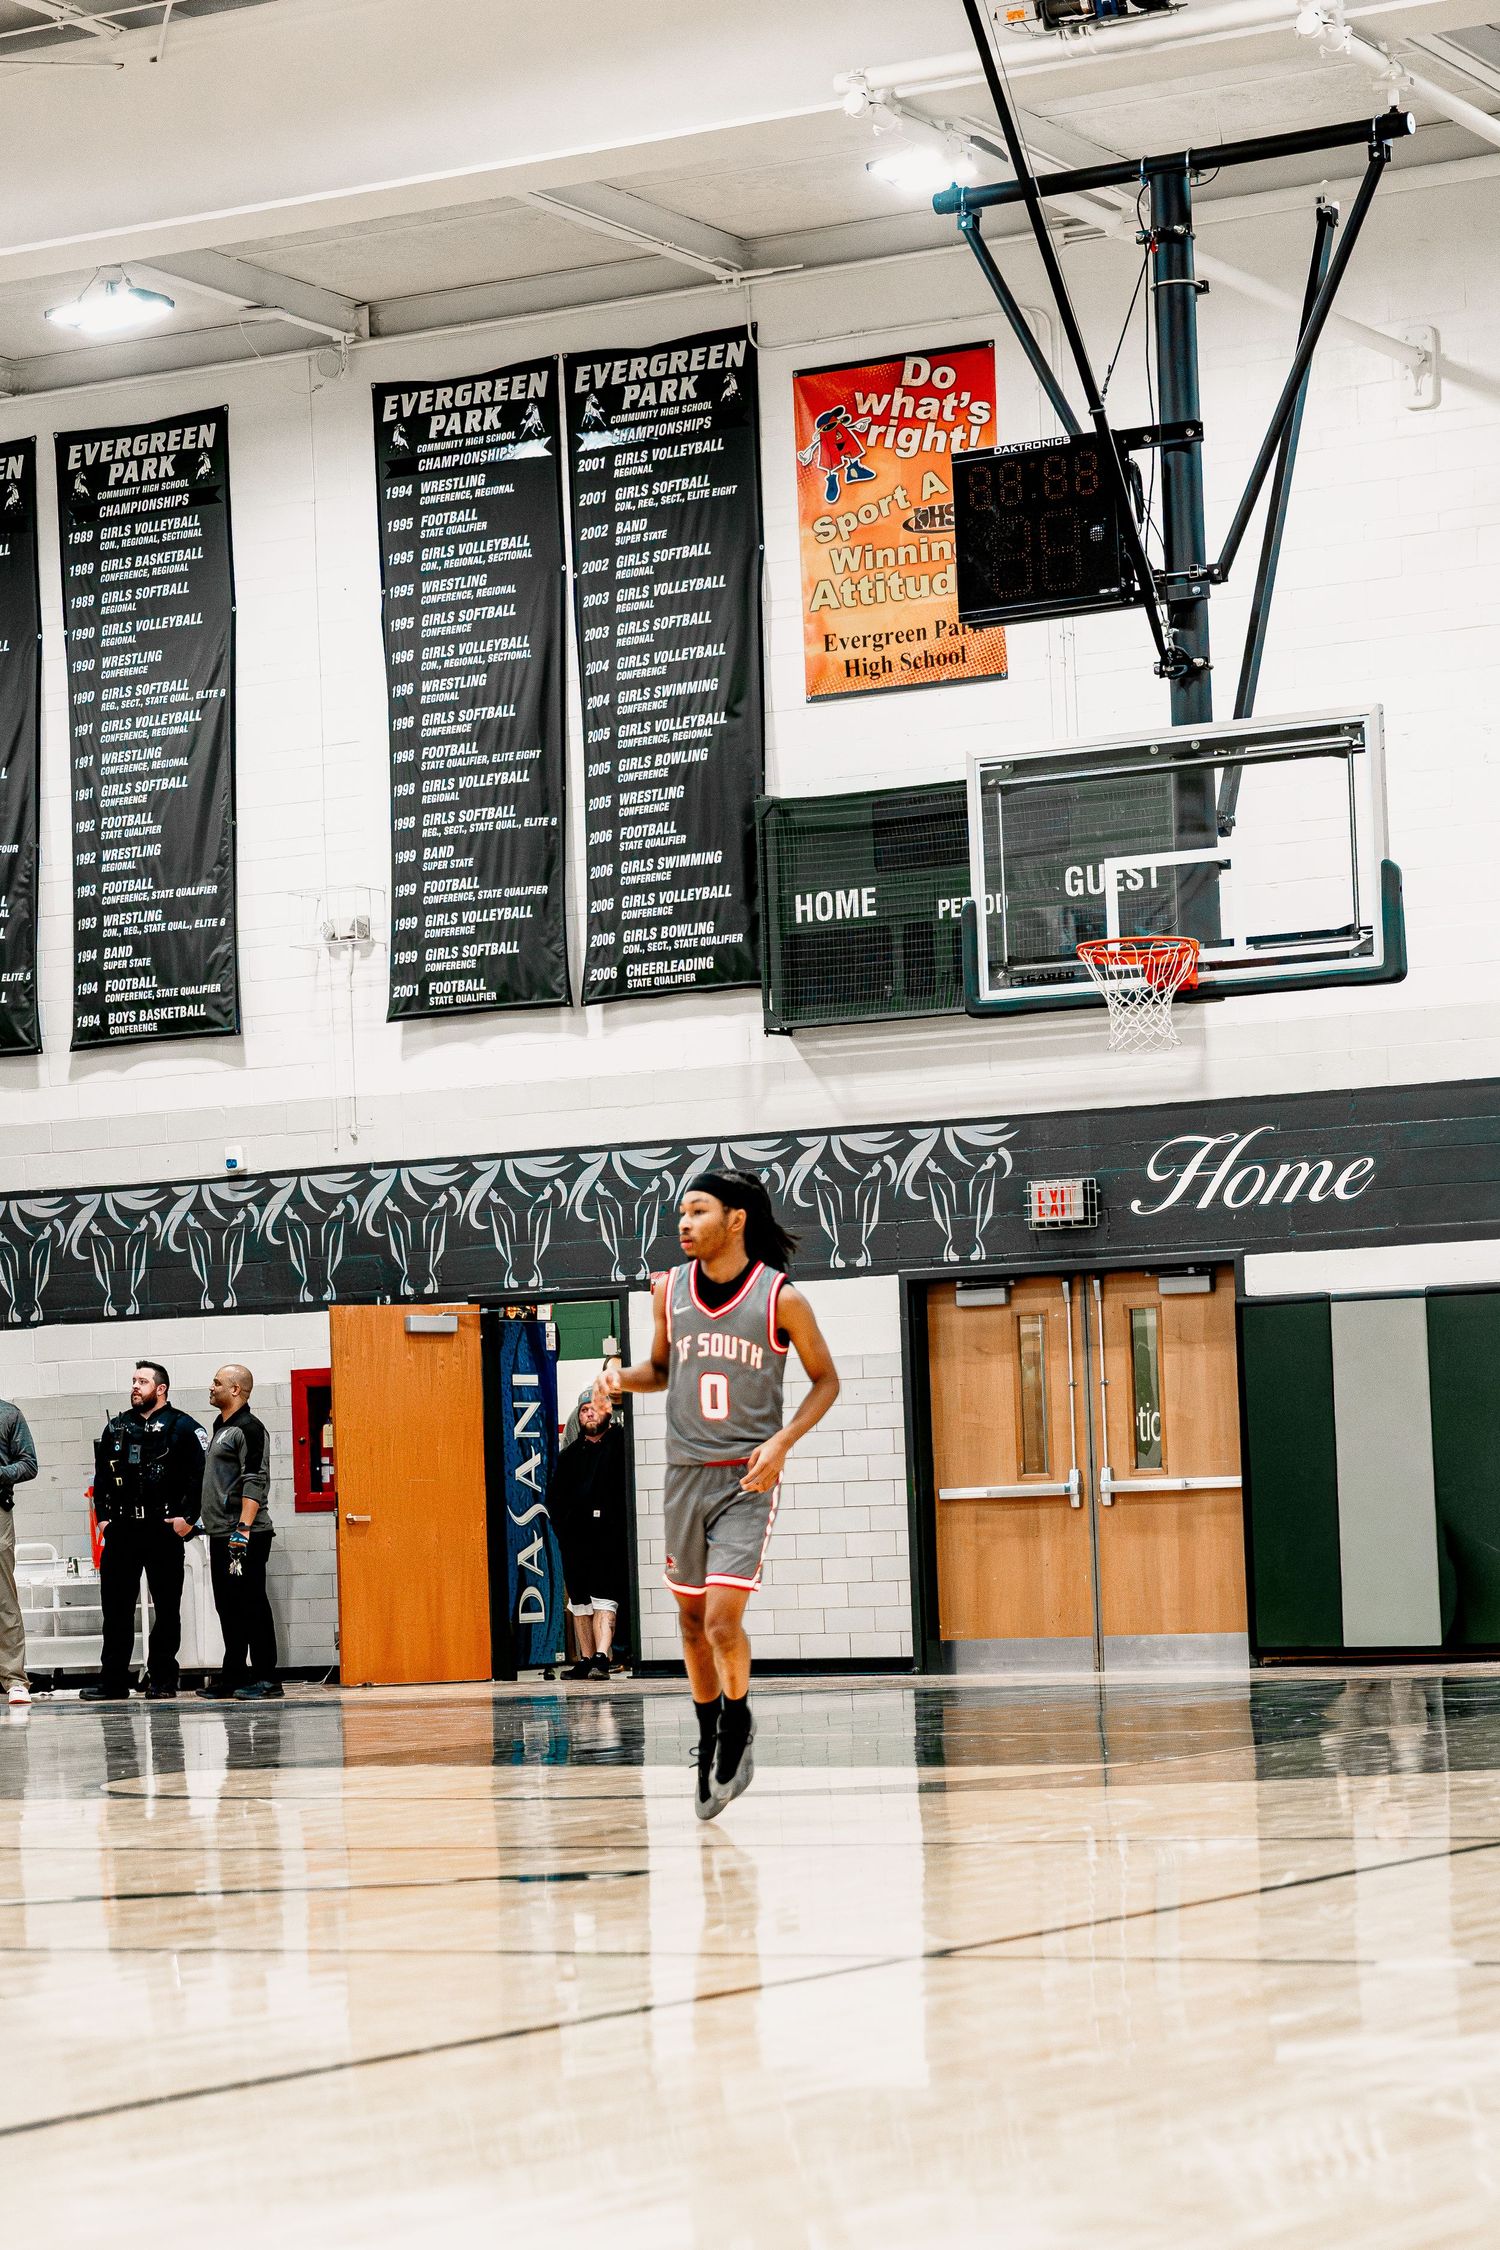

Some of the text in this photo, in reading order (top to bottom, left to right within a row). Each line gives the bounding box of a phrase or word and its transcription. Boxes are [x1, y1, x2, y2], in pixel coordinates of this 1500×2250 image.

[574, 340, 747, 394] EVERGREEN
[902, 356, 956, 390] Do
[382, 370, 549, 423] EVERGREEN
[622, 375, 699, 411] PARK
[610, 401, 713, 424] COMMUNITY HIGH SCHOOL
[854, 387, 991, 425] what's
[428, 405, 503, 440] PARK
[612, 416, 712, 444] CHAMPIONSHIPS
[68, 422, 216, 470] EVERGREEN
[417, 432, 517, 454] COMMUNITY HIGH SCHOOL
[865, 415, 981, 458] right!
[994, 436, 1070, 454] DAKTRONICS
[108, 454, 176, 486] PARK
[418, 446, 516, 472] CHAMPIONSHIPS
[97, 478, 190, 500] COMMUNITY HIGH SCHOOL
[386, 473, 486, 499] 1994 WRESTLING
[419, 483, 514, 505] CONFERENCE, REGIONAL
[578, 474, 710, 506] 2001 GIRLS SOFTBALL
[614, 484, 737, 512] CON., REG., SECT., ELITE EIGHT
[100, 494, 189, 518] CHAMPIONSHIPS
[812, 471, 949, 544] Sport A
[912, 502, 954, 531] IHS
[68, 514, 200, 544] 1989 GIRLS VOLLEYBALL
[99, 527, 202, 550] CON., REGIONAL, SECTIONAL
[580, 518, 647, 540] 2002 BAND
[614, 528, 667, 546] SUPER STATE
[388, 534, 530, 565] 1995 GIRLS VOLLEYBALL
[420, 548, 532, 571] CON., REGIONAL, SECTIONAL
[830, 534, 956, 575] Winnin
[70, 581, 189, 609] 1989 GIRLS SOFTBALL
[582, 574, 726, 608] 2003 GIRLS VOLLEYBALL
[809, 566, 956, 612] Attitud
[100, 602, 136, 615] REGIONAL
[390, 603, 516, 632] 1995 GIRLS SOFTBALL
[615, 599, 654, 613] REGIONAL
[71, 612, 202, 640] 1990 GIRLS VOLLEYBALL
[421, 623, 472, 638] CONFERENCE
[824, 620, 982, 654] Evergreen Par
[100, 634, 136, 647] REGIONAL
[72, 649, 162, 673] 1990 WRESTLING
[100, 665, 148, 679] CONFERENCE
[844, 646, 967, 680] High School
[392, 673, 487, 698] 1996 WRESTLING
[420, 691, 459, 704] REGIONAL
[586, 677, 718, 709] 2004 GIRLS SWIMMING
[616, 699, 668, 715] CONFERENCE
[588, 711, 727, 743] 2005 GIRLS VOLLEYBALL
[617, 727, 712, 749] CONFERENCE, REGIONAL
[75, 746, 162, 769] 1991 WRESTLING
[393, 741, 478, 764] 1998 FOOTBALL
[420, 749, 542, 770] STATE QUALIFIER, ELITE EIGHT
[100, 756, 188, 775] CONFERENCE, REGIONAL
[588, 785, 684, 810] 2005 WRESTLING
[618, 801, 669, 817] CONFERENCE
[76, 812, 153, 832] 1992 FOOTBALL
[100, 824, 161, 840] STATE QUALIFIER
[589, 820, 676, 845] 2006 FOOTBALL
[395, 845, 454, 864] 1999 BAND
[619, 834, 686, 851] STATE QUALIFIER
[422, 857, 474, 871] SUPER STATE
[77, 877, 153, 898] 1993 FOOTBALL
[101, 884, 217, 905] CONFERENCE, STATE QUALIFIER
[796, 886, 1008, 924] HOME PEOD
[395, 905, 533, 930] 1999 GIRLS VOLLEYBALL
[424, 925, 475, 938] CONFERENCE
[2, 973, 22, 982] ELITE
[589, 956, 714, 981] 2006 CHEERLEADING
[627, 972, 695, 988] STATE QUALIFIER
[1026, 970, 1074, 983] GARED
[393, 978, 486, 998] 2001 FOOTBALL
[429, 991, 496, 1005] STATE QUALIFIER
[77, 1004, 206, 1027] 1994 BOYS BASKETBALL
[109, 1022, 158, 1035] CONFERENCE
[1130, 1126, 1376, 1215] Home
[1038, 1186, 1077, 1218] EXIT
[697, 1332, 764, 1370] SOUTH
[699, 1372, 730, 1420] 0
[506, 1374, 550, 1624] DASANI
